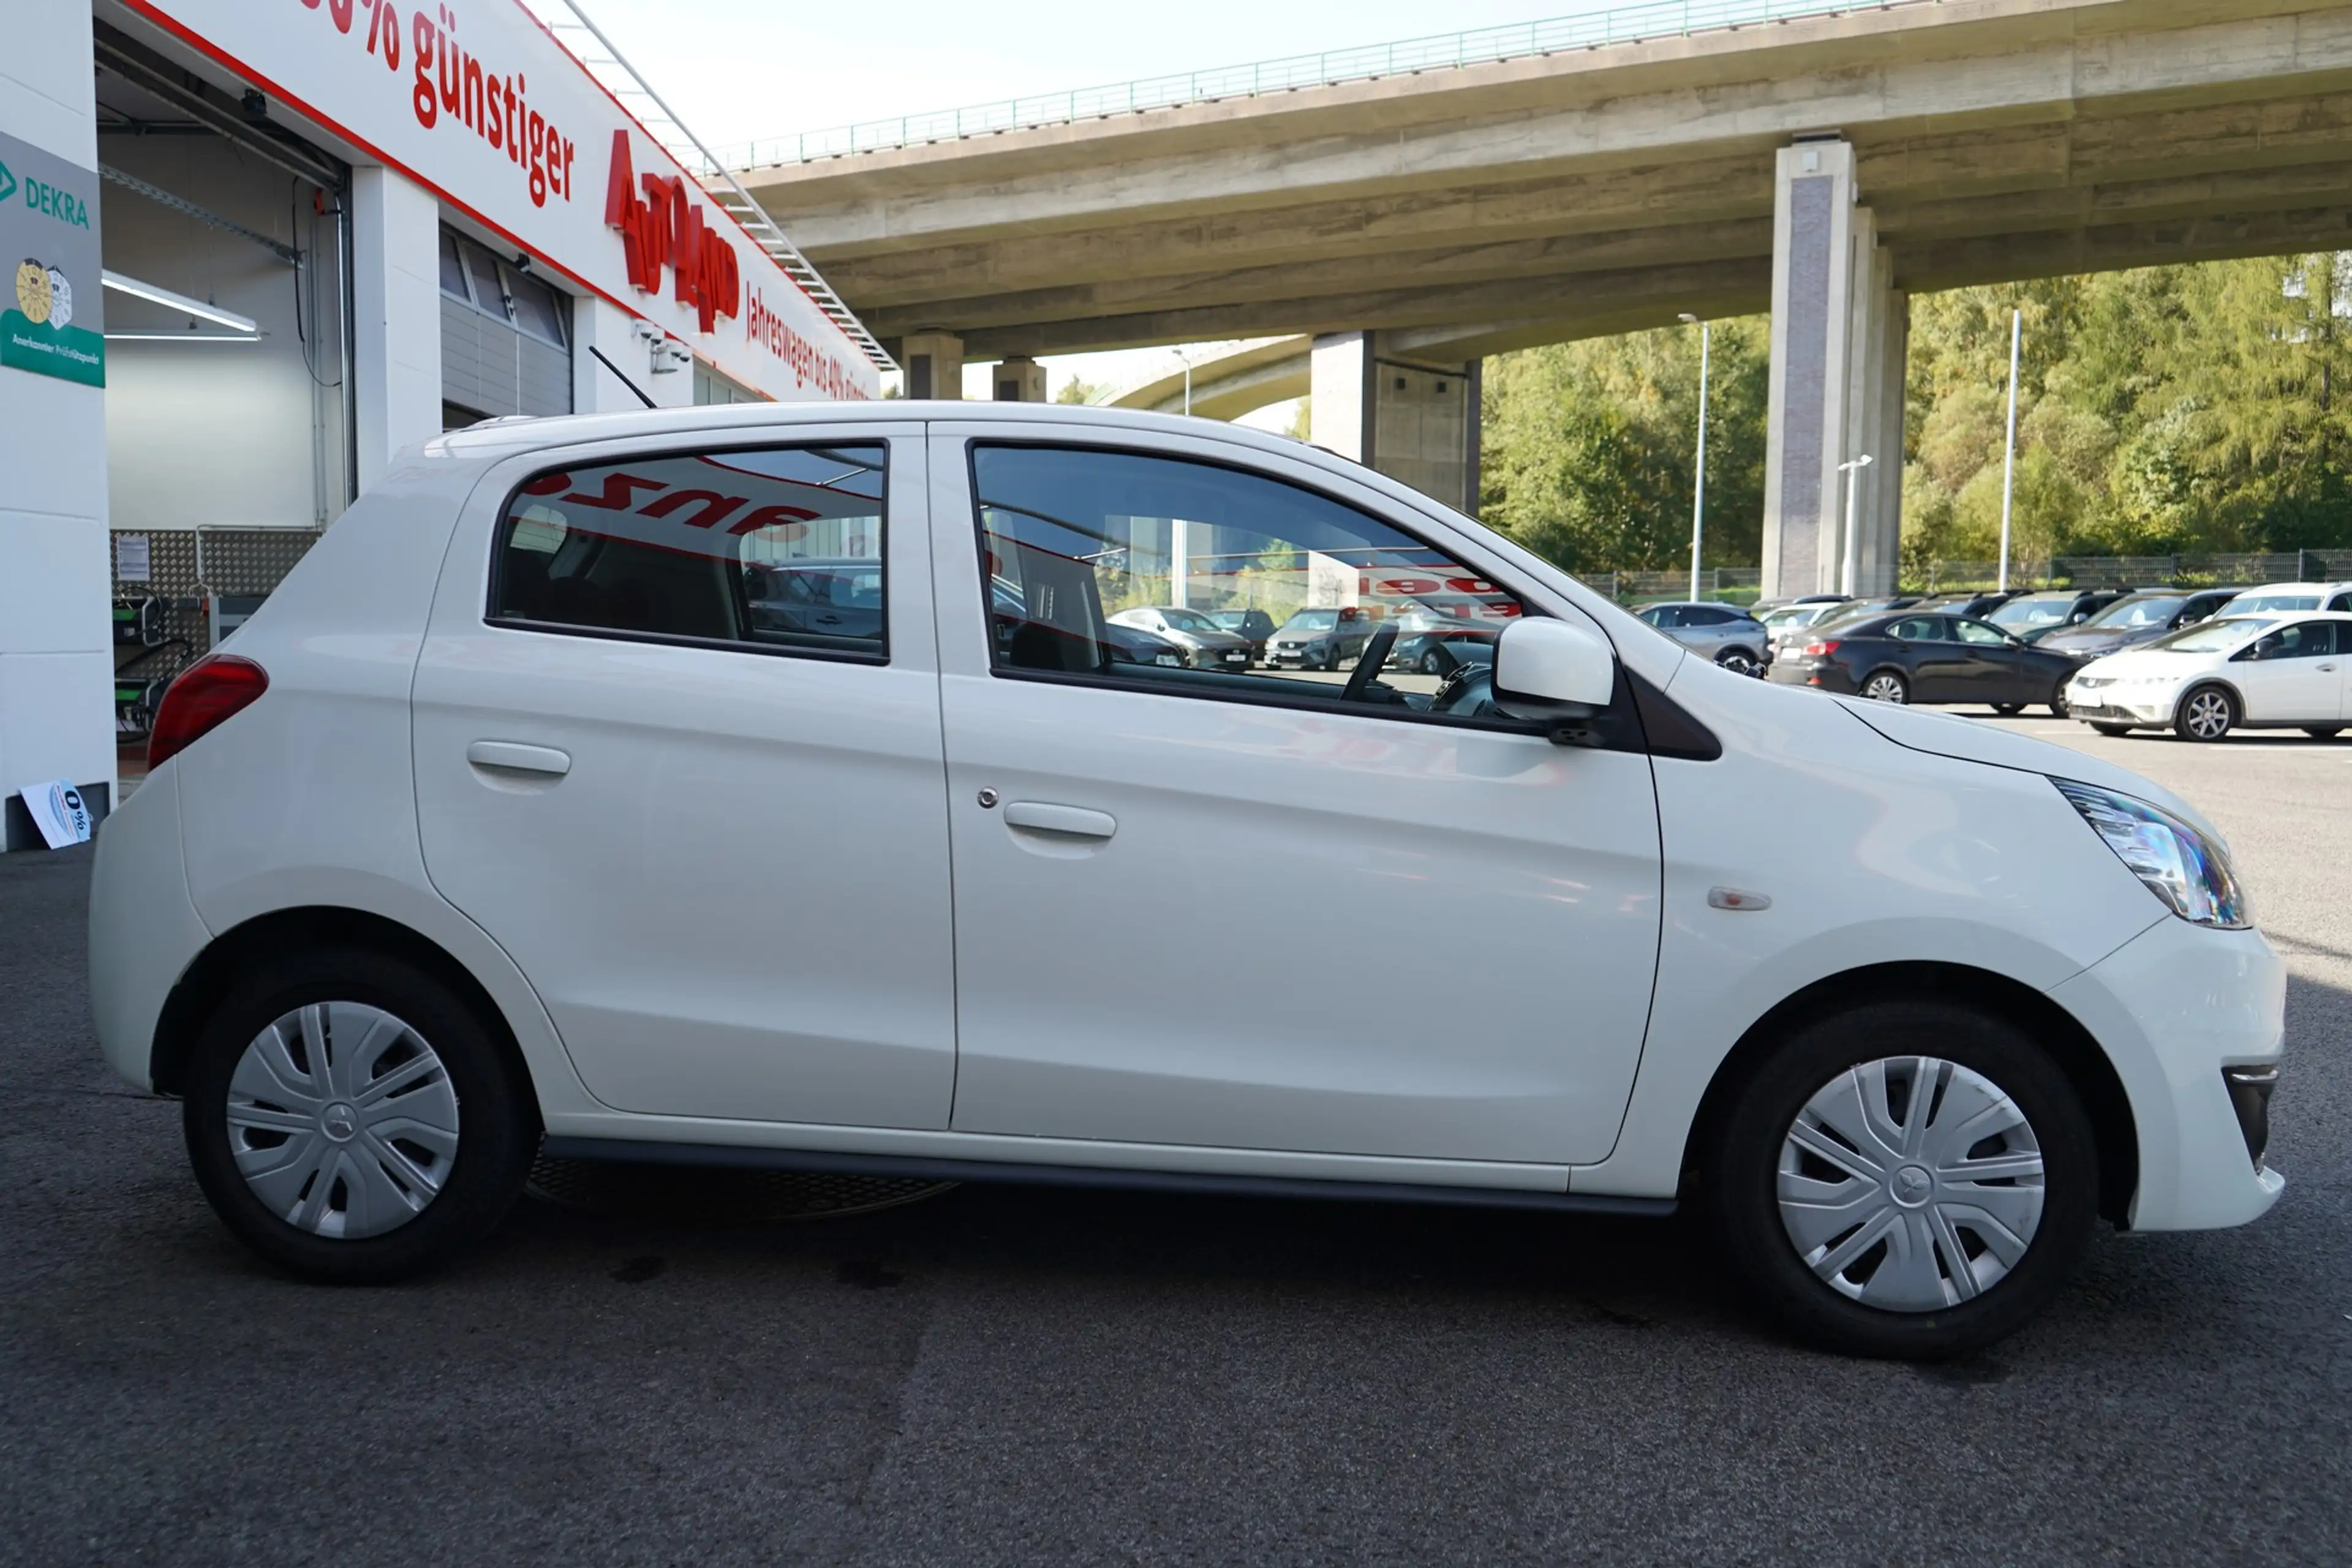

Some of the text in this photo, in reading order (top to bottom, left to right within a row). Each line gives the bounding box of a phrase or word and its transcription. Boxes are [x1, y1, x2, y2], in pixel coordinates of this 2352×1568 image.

[413, 2, 574, 208] günstiger
[25, 176, 89, 230] DEKRA
[746, 280, 814, 389] Jahreswagen
[64, 790, 86, 831] 0%
